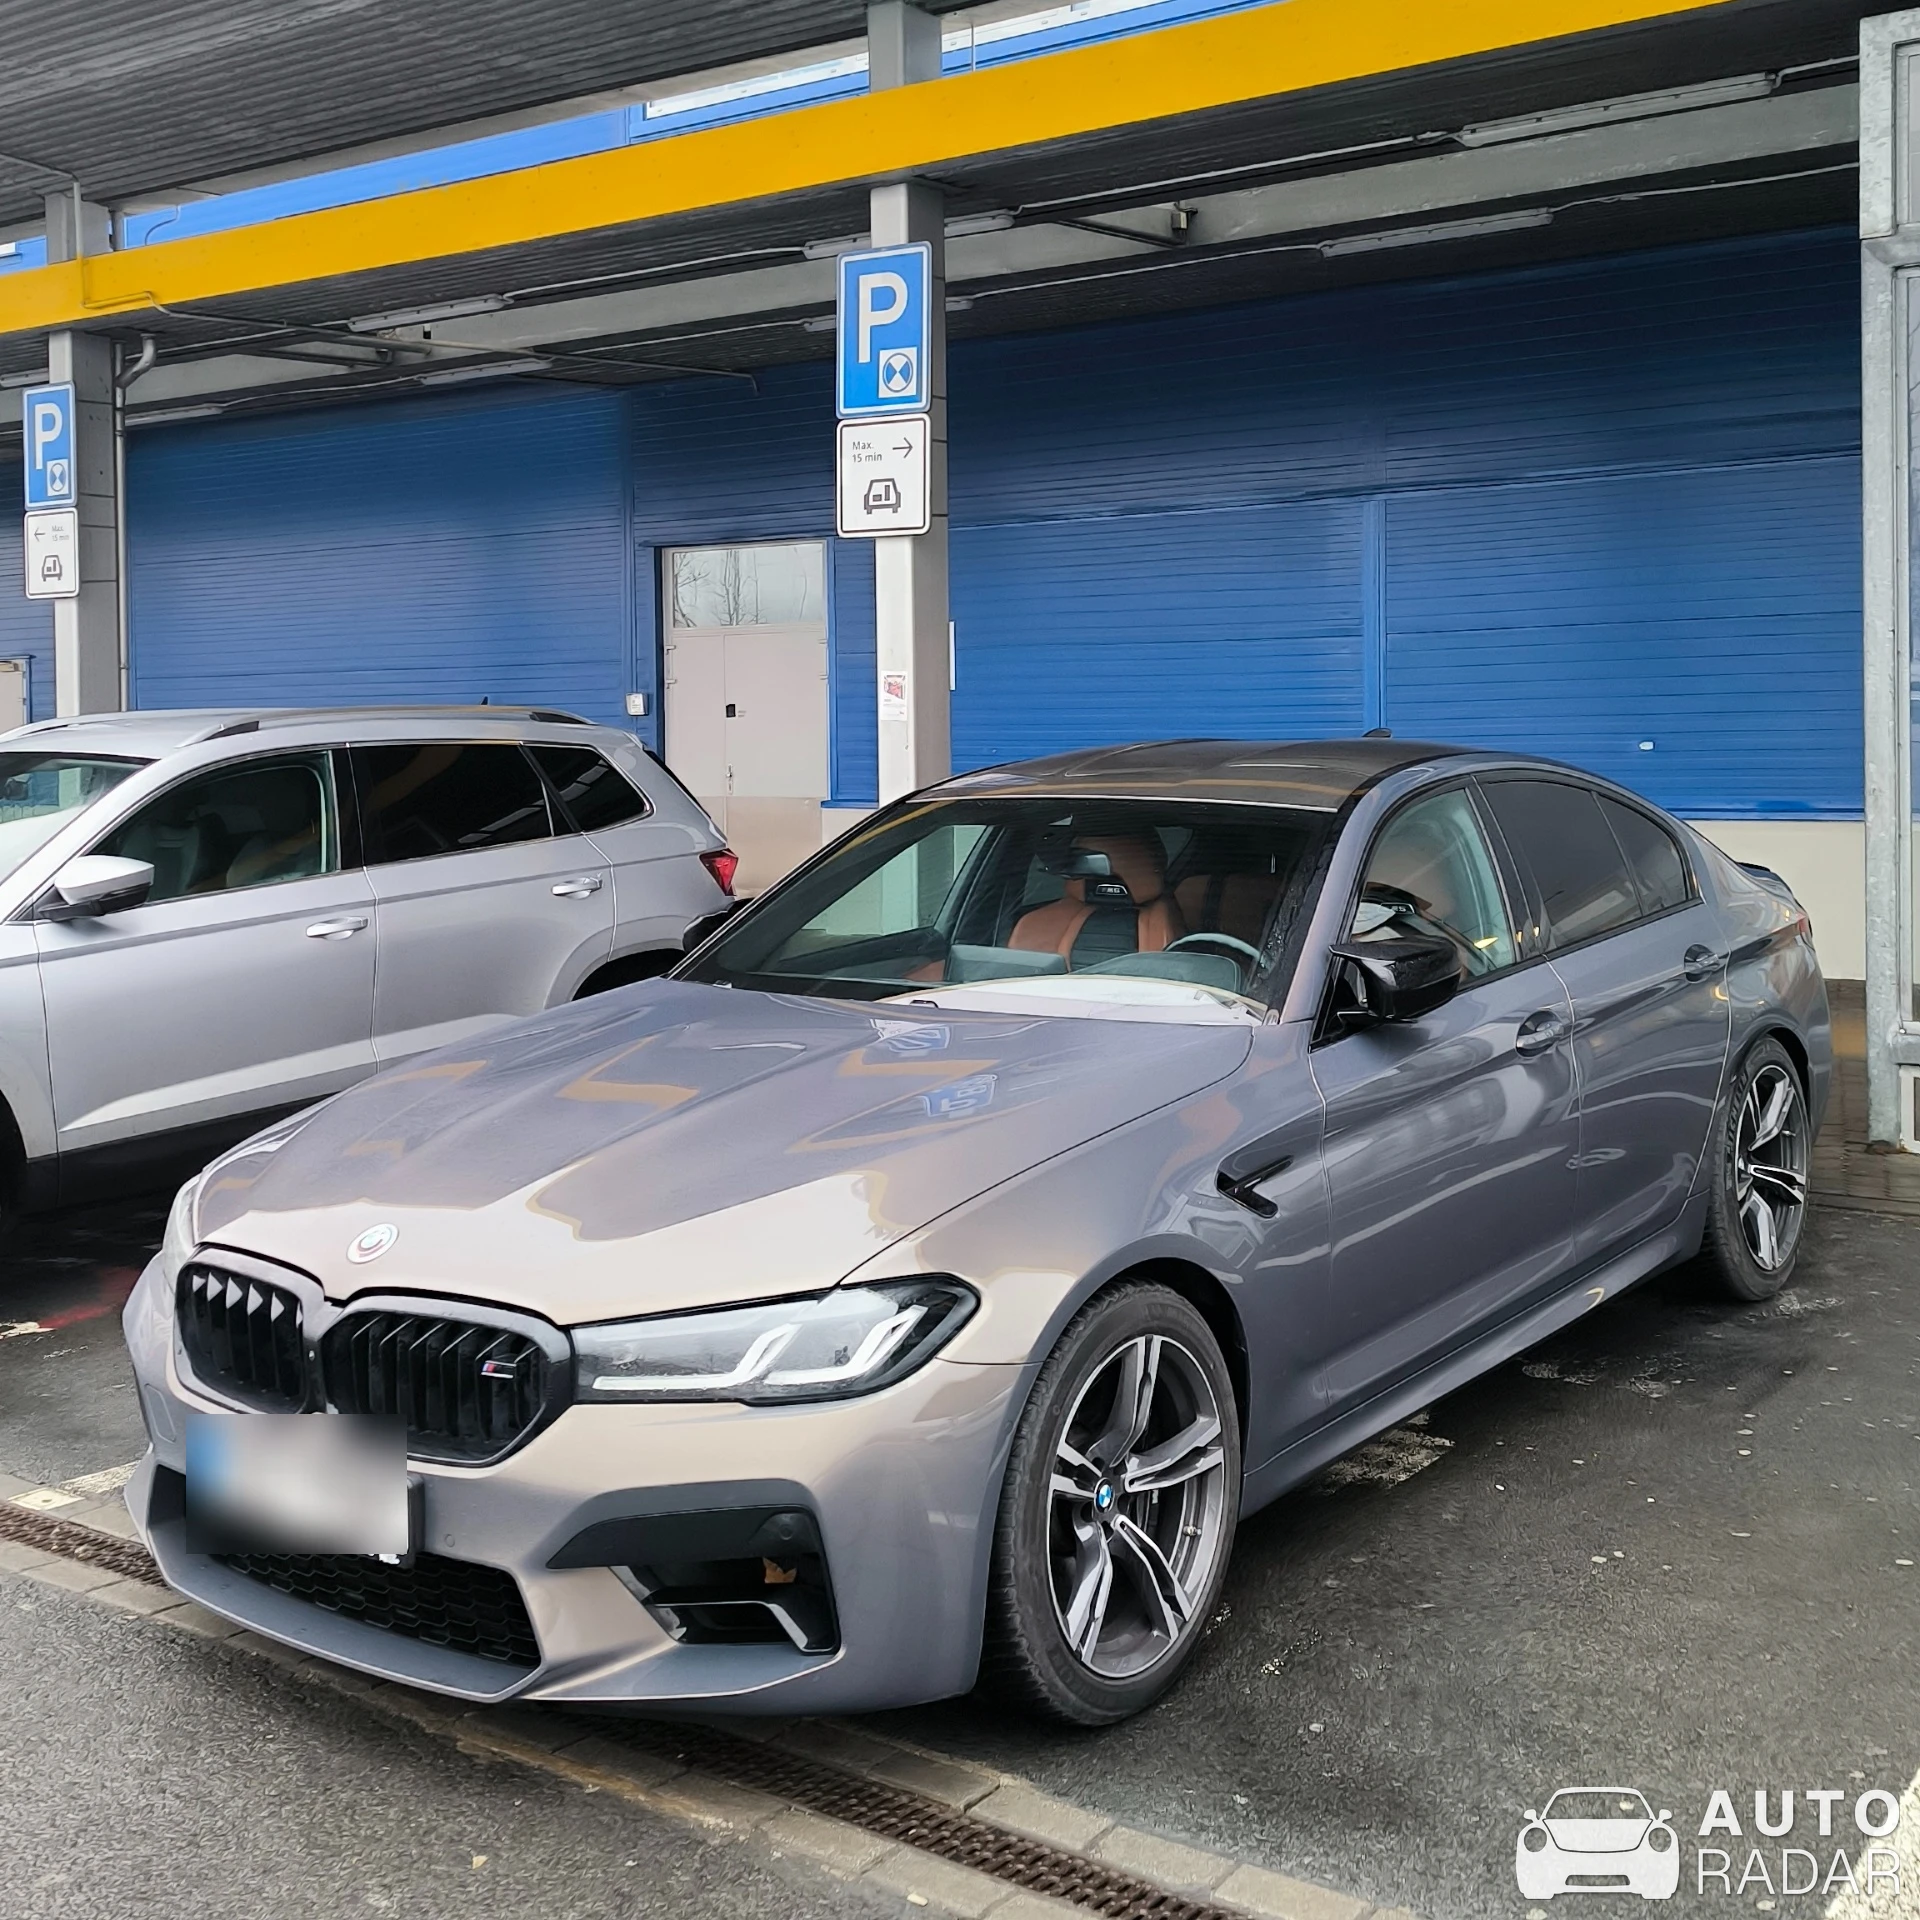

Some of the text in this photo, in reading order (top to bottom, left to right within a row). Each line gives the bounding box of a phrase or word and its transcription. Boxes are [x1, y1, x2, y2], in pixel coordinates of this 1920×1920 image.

[858, 271, 908, 363] P
[34, 402, 63, 470] P
[852, 452, 883, 463] 15 min
